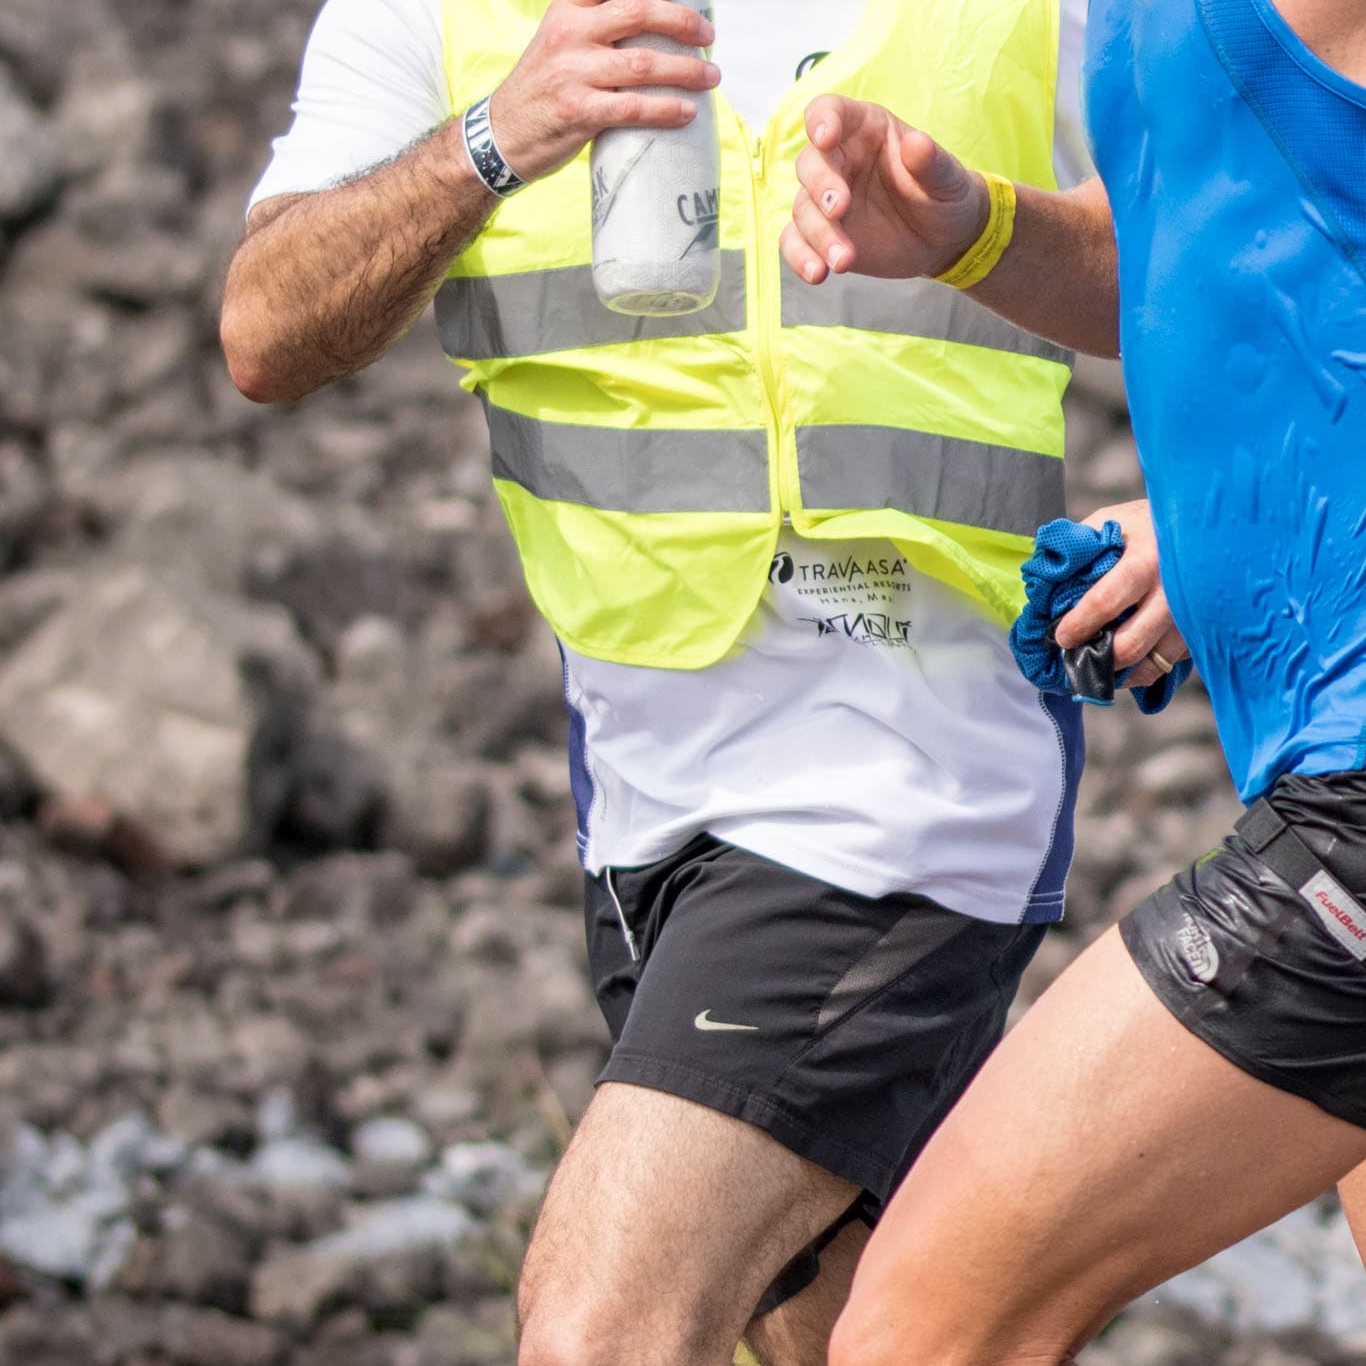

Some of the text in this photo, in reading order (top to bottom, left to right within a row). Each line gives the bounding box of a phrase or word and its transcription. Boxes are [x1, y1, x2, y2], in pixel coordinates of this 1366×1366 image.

[799, 555, 905, 583] TRAVAASA
[797, 581, 869, 595] EXPERIENTIAL
[1176, 926, 1201, 962] FACE
